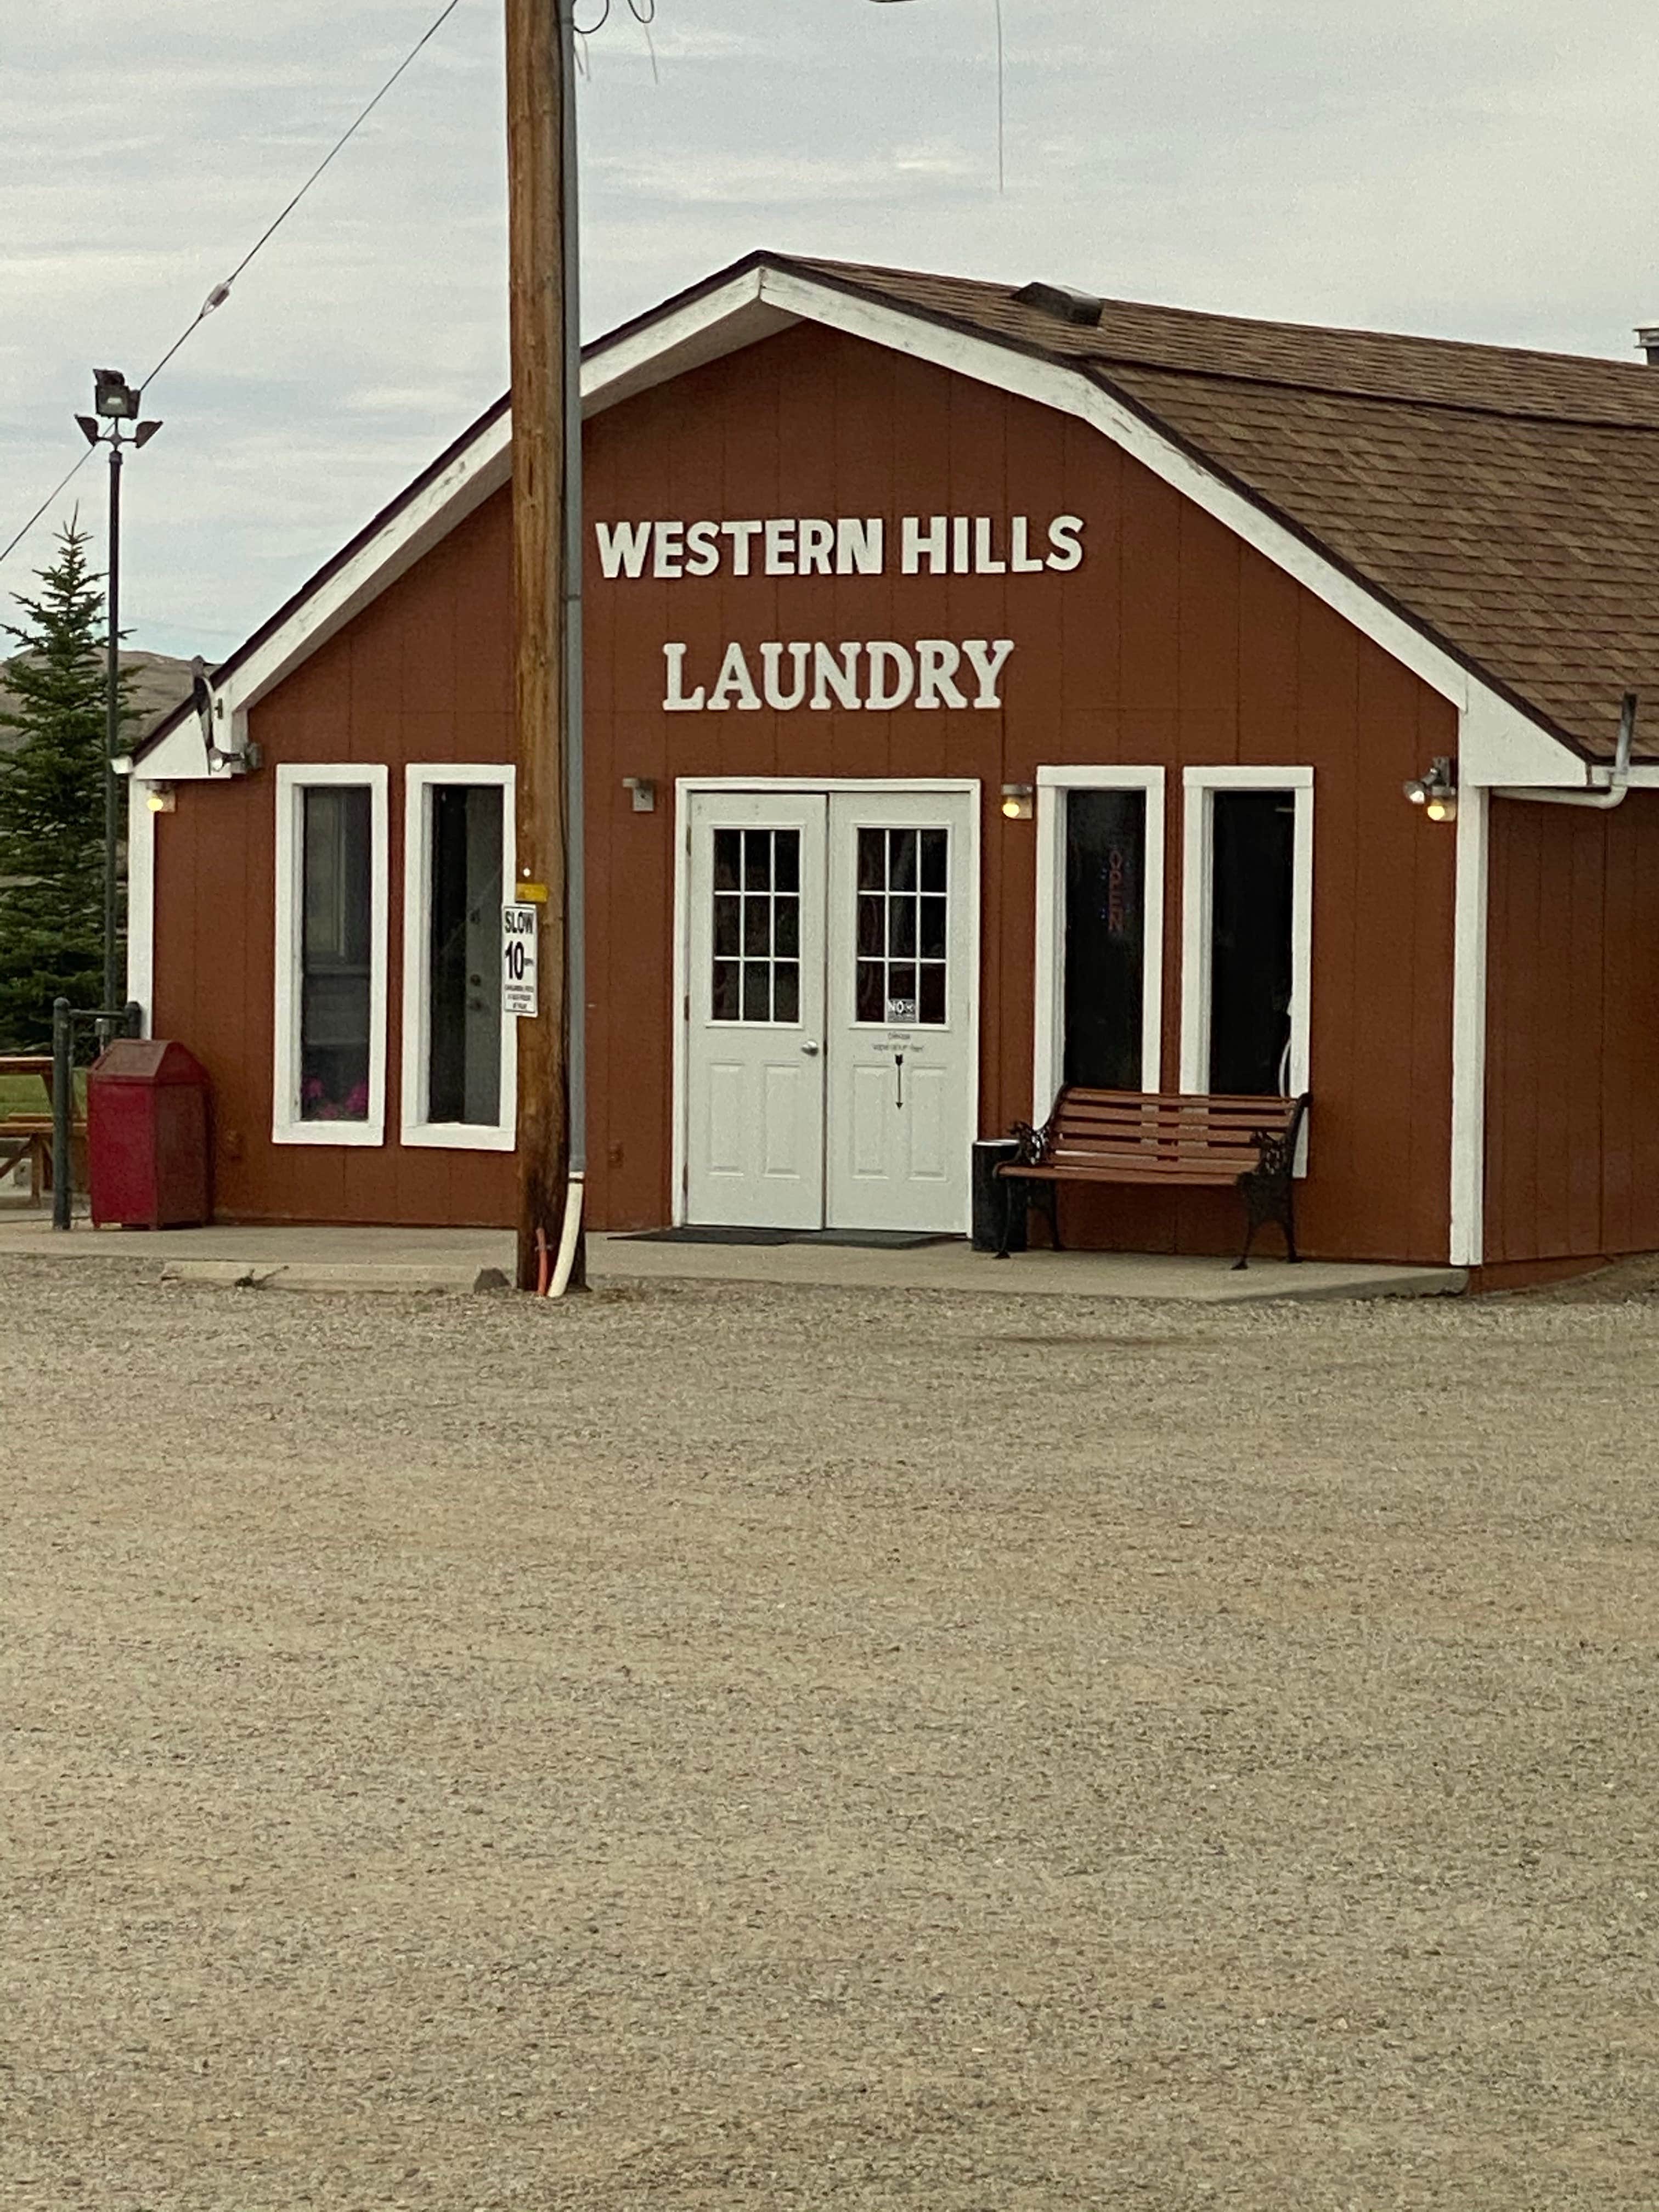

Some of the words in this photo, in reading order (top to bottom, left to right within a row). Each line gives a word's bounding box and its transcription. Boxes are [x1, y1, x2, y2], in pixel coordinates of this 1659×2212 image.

[595, 518, 883, 578] WESTERN
[901, 516, 1084, 574] HILLS
[663, 640, 1014, 710] LAUNDRY
[504, 911, 533, 934] SLOW
[1109, 850, 1124, 933] OPEN
[504, 940, 524, 980] 10
